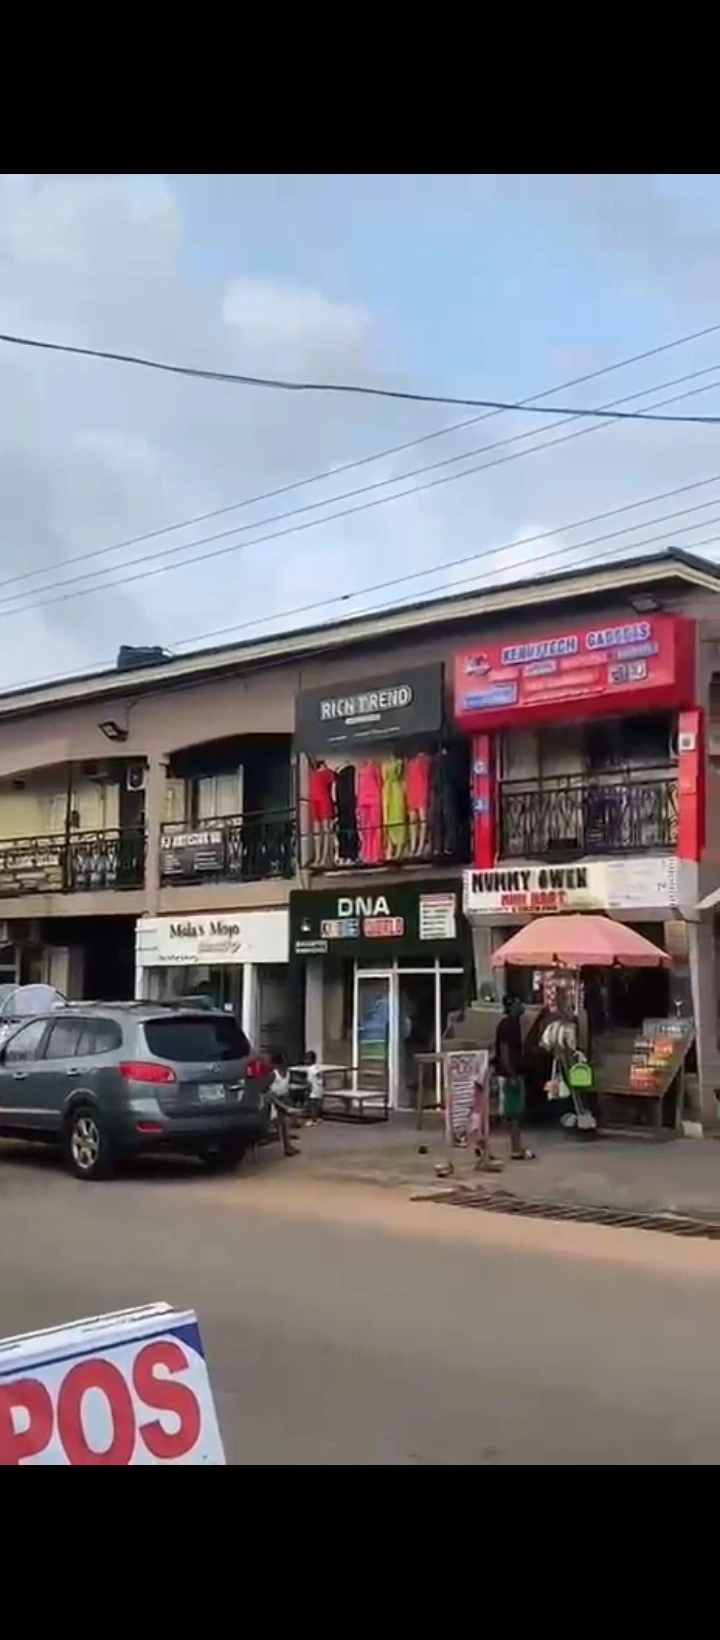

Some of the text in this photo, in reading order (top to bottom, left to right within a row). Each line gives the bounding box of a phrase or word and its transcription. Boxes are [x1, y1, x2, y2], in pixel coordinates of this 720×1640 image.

[320, 701, 355, 720] RICH
[357, 686, 411, 713] TREND
[472, 871, 532, 893] MUMMY
[337, 896, 390, 916] DNA
[0, 1340, 201, 1465] POS
